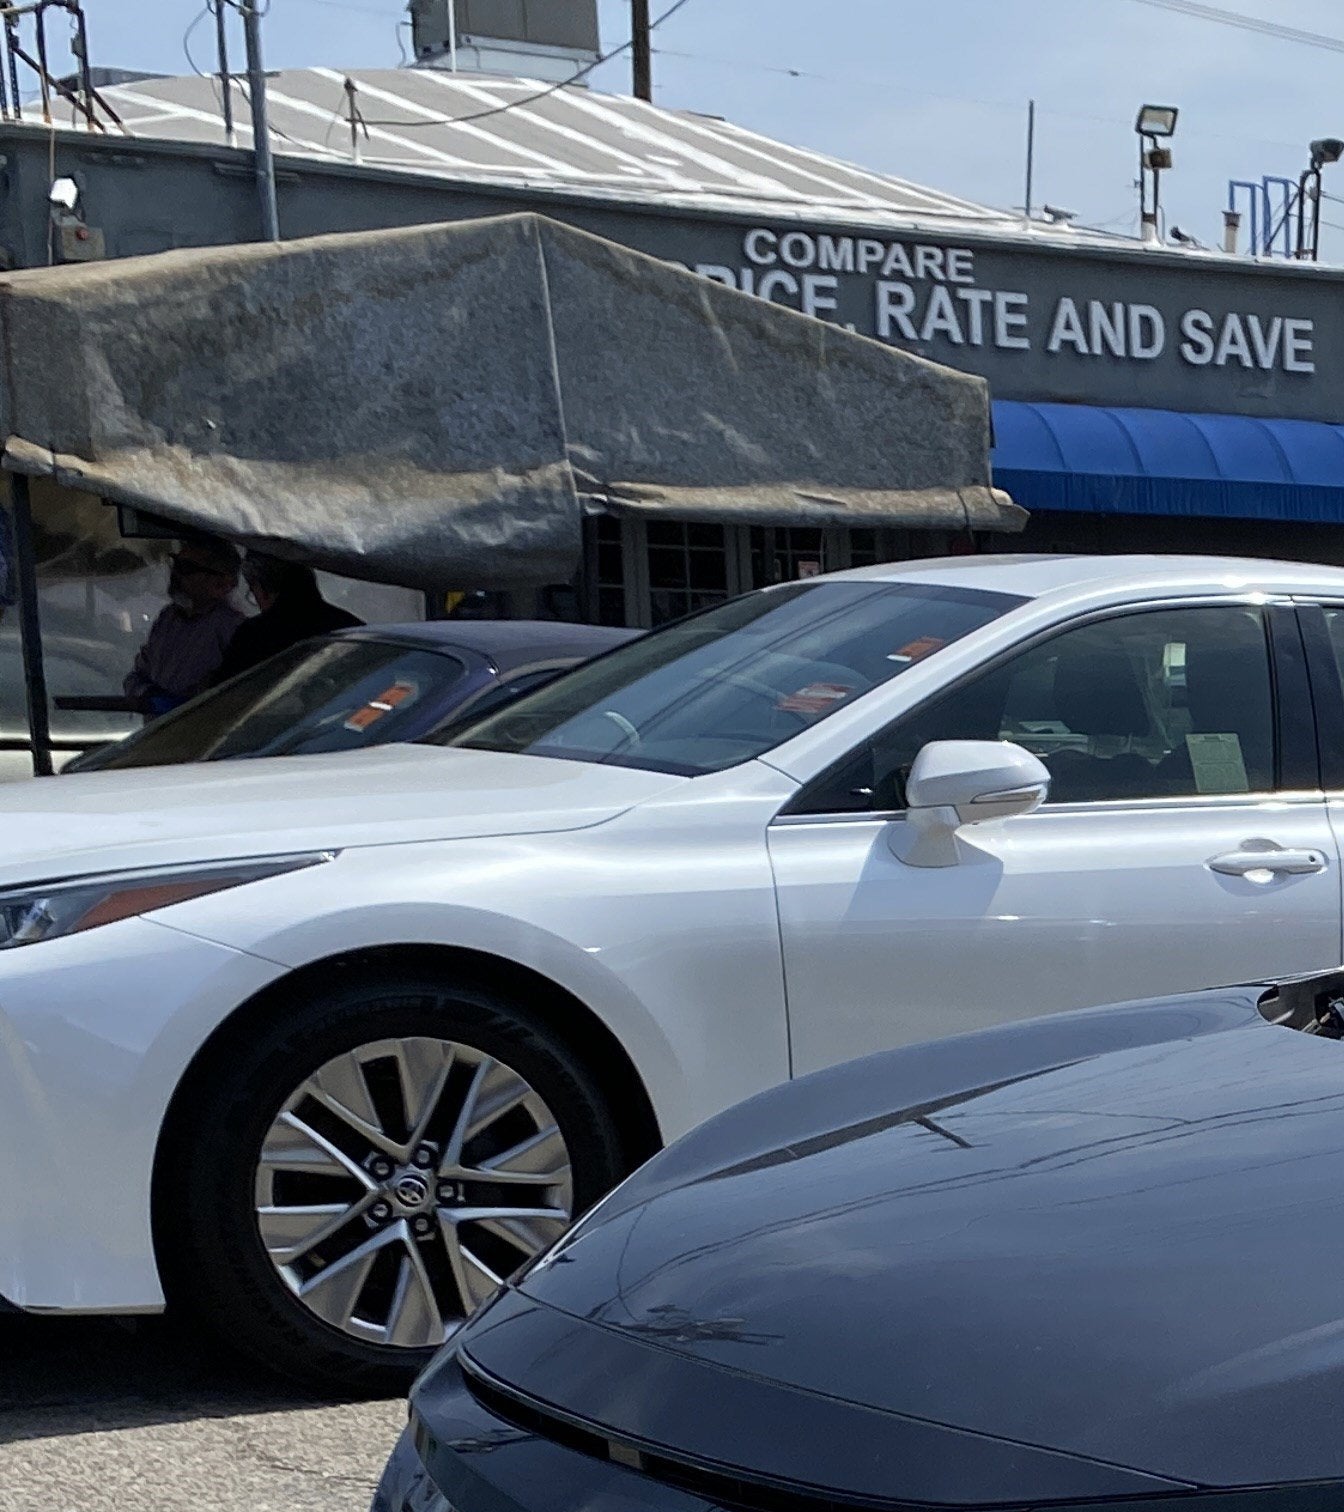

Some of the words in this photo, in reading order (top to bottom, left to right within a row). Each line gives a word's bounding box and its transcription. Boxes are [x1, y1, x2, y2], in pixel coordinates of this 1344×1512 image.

[744, 228, 975, 284] COMPARE
[874, 280, 1031, 349] RATE
[1047, 297, 1165, 359] AND
[1180, 308, 1315, 373] SAVE
